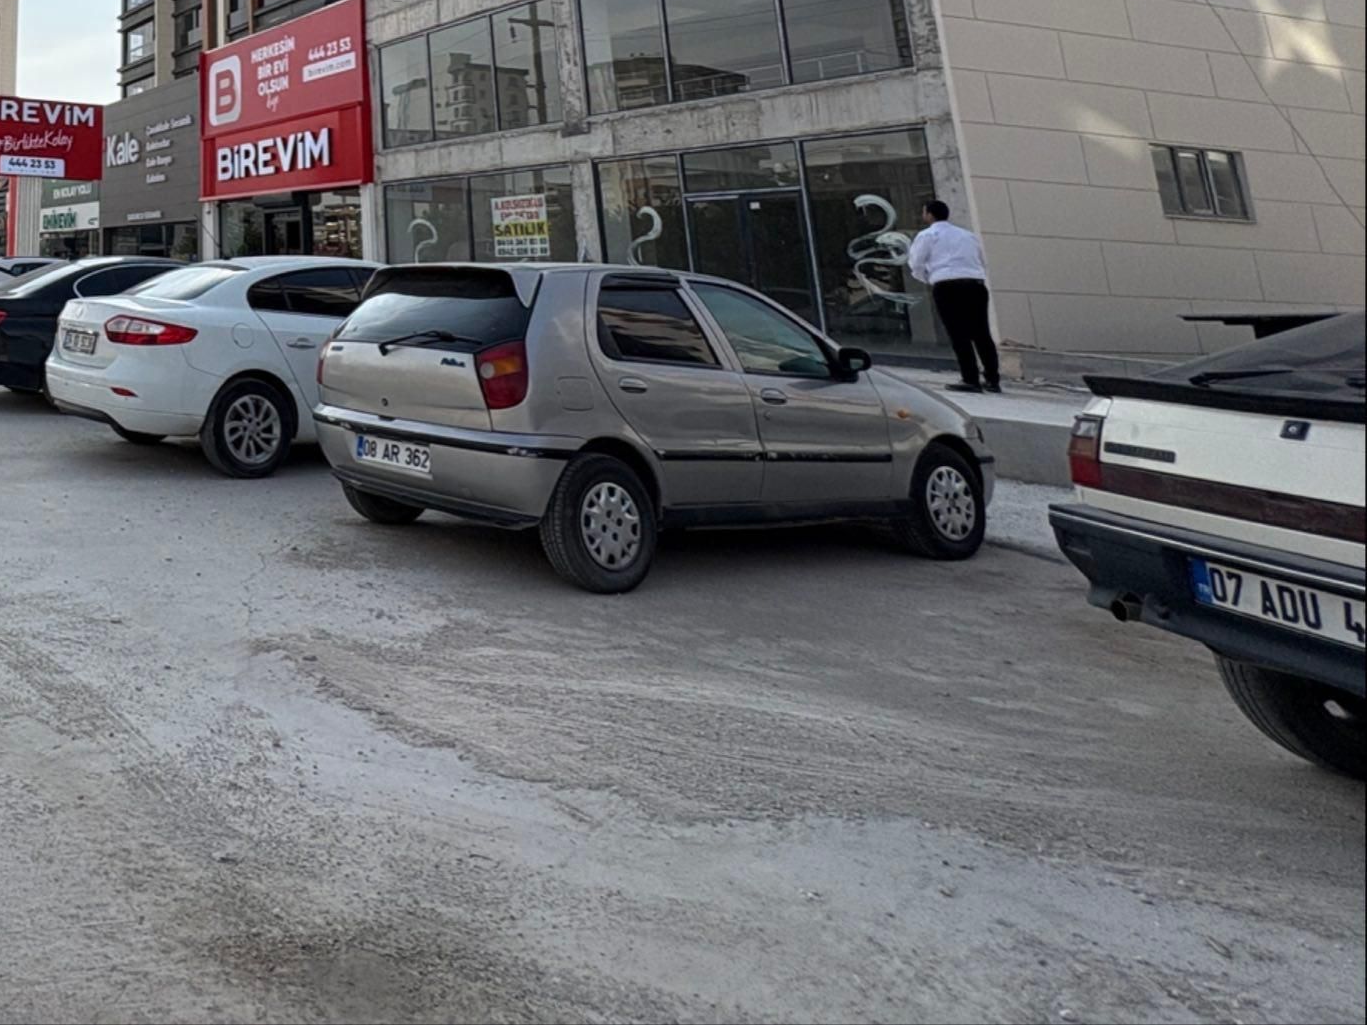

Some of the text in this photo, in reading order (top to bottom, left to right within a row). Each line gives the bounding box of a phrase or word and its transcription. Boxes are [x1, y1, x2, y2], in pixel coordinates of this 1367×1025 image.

[251, 35, 295, 65] HERKESİN
[308, 36, 351, 61] 444 23 53
[257, 53, 289, 80] BİR EVİ
[257, 75, 289, 96] OLSUN
[8, 156, 56, 170] 444 23 53
[106, 131, 140, 168] Kale
[494, 222, 547, 237] SATILIK
[364, 439, 430, 469] 08 AR 362
[1209, 567, 1243, 607] 07
[1261, 580, 1322, 630] ADU
